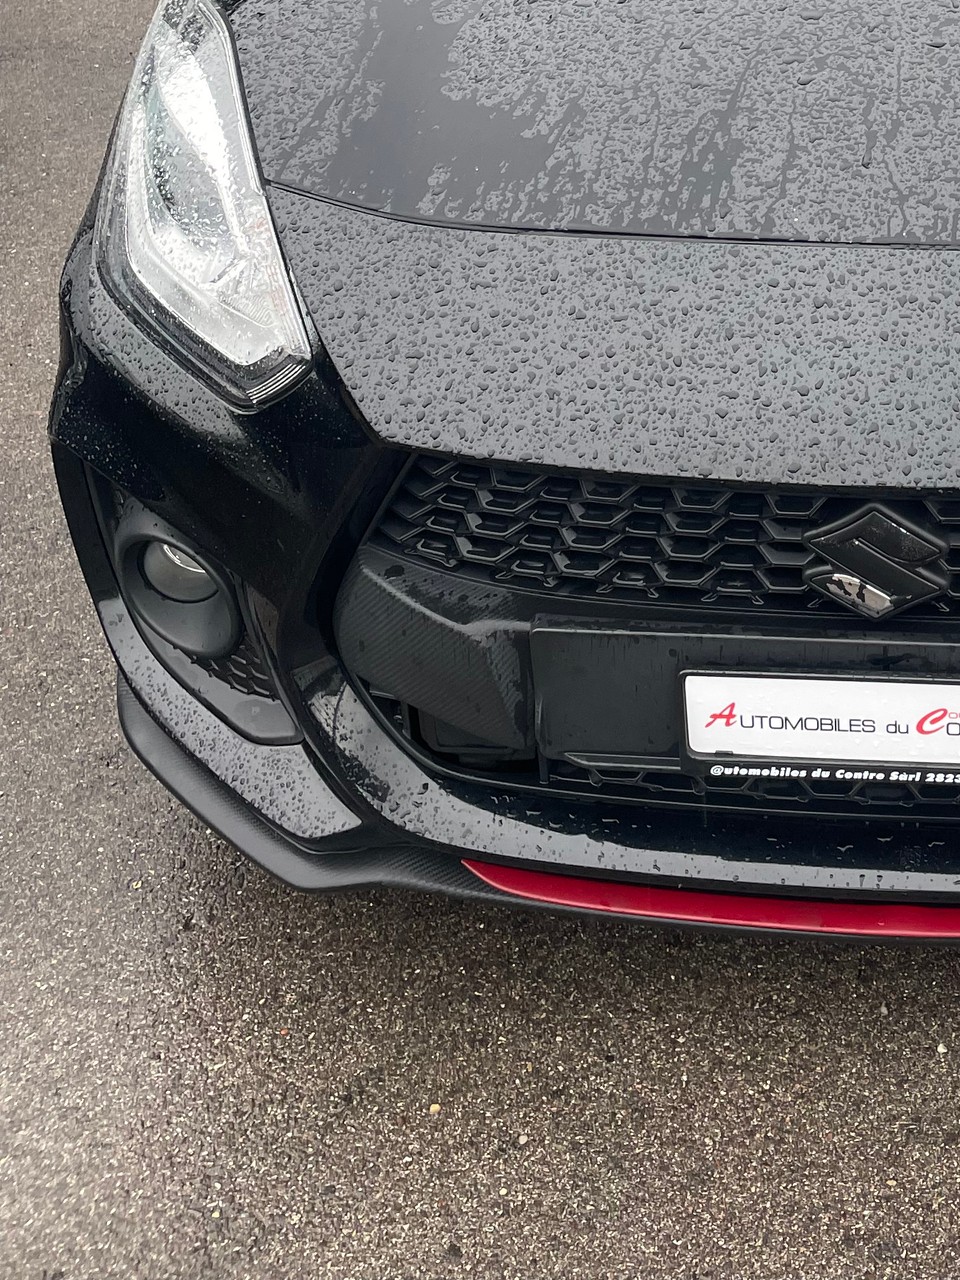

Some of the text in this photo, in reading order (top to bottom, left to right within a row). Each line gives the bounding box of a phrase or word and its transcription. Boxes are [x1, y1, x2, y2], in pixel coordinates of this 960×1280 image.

[886, 720, 909, 734] du
[710, 764, 807, 778] @utomobiles
[811, 768, 831, 779] du
[835, 769, 885, 781] Contre
